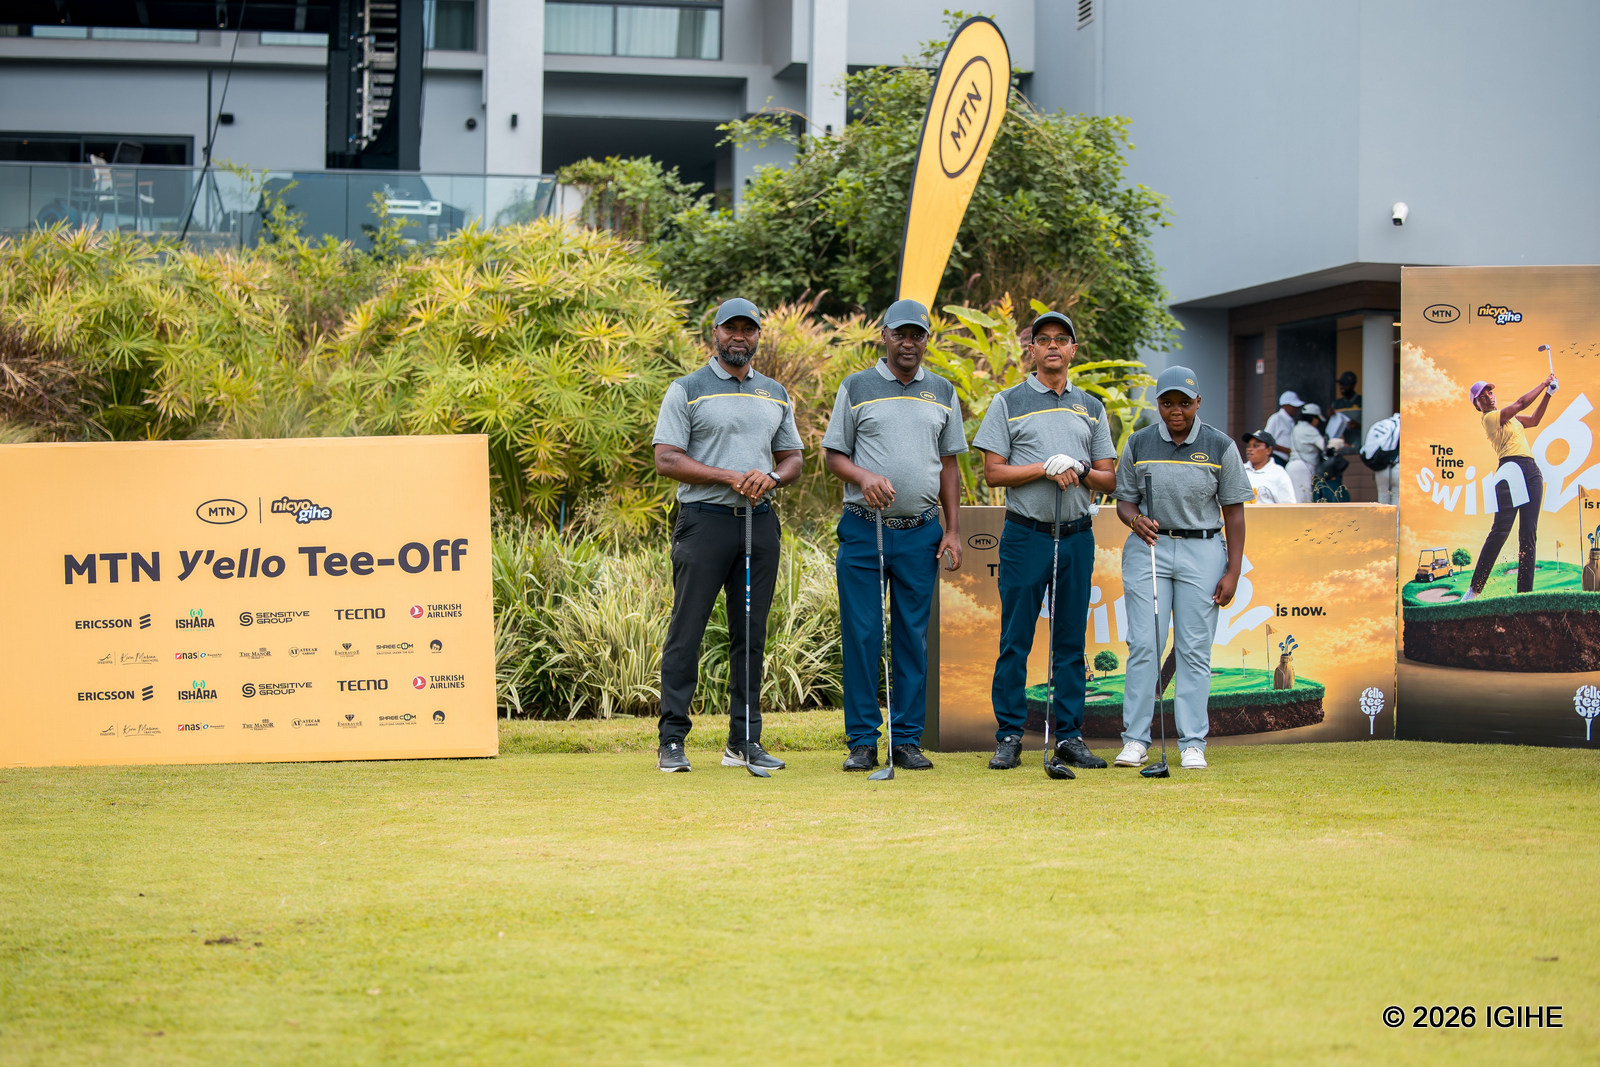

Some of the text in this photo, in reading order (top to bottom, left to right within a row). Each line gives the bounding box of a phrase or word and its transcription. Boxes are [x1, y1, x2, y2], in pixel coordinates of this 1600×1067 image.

[950, 80, 982, 152] MTN
[1479, 304, 1507, 318] nicyo
[1497, 312, 1521, 324] gihe
[1430, 444, 1454, 456] The
[1436, 456, 1464, 468] time
[1442, 468, 1454, 479] to
[272, 498, 311, 514] nicyo
[1584, 498, 1594, 509] is
[208, 506, 235, 516] MTN
[298, 505, 331, 522] gihe
[64, 552, 160, 584] MTN
[298, 538, 468, 576] Tee-Off
[334, 608, 386, 620] TECNO
[426, 610, 462, 618] AIRLINES
[1276, 603, 1326, 616] is now.
[75, 618, 132, 630] ERICSSON
[176, 616, 215, 628] ISHARA
[337, 678, 388, 692] TECNO
[430, 681, 465, 689] AIRLINES
[78, 690, 135, 701] ERICSSON
[178, 688, 218, 700] ISHARA
